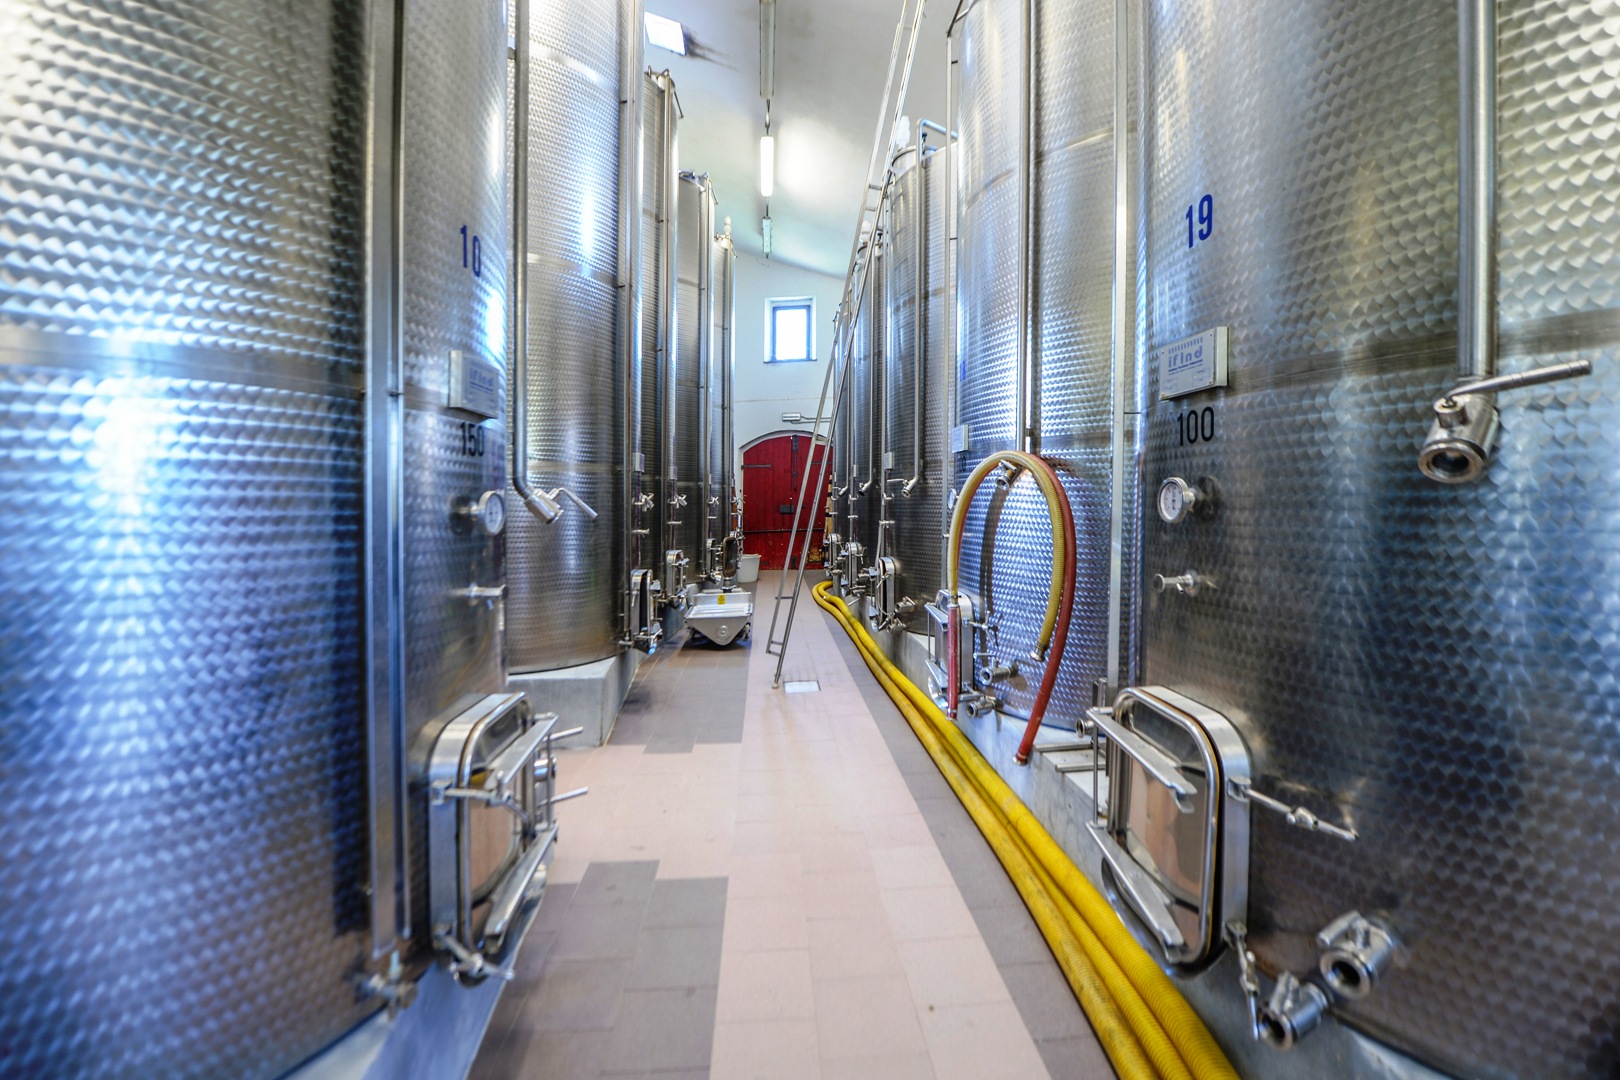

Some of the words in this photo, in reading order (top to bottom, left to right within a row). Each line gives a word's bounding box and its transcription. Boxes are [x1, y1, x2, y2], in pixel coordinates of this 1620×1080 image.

[1186, 194, 1213, 249] 19
[460, 224, 481, 278] 10
[460, 421, 485, 457] 150
[1177, 406, 1214, 446] 100
